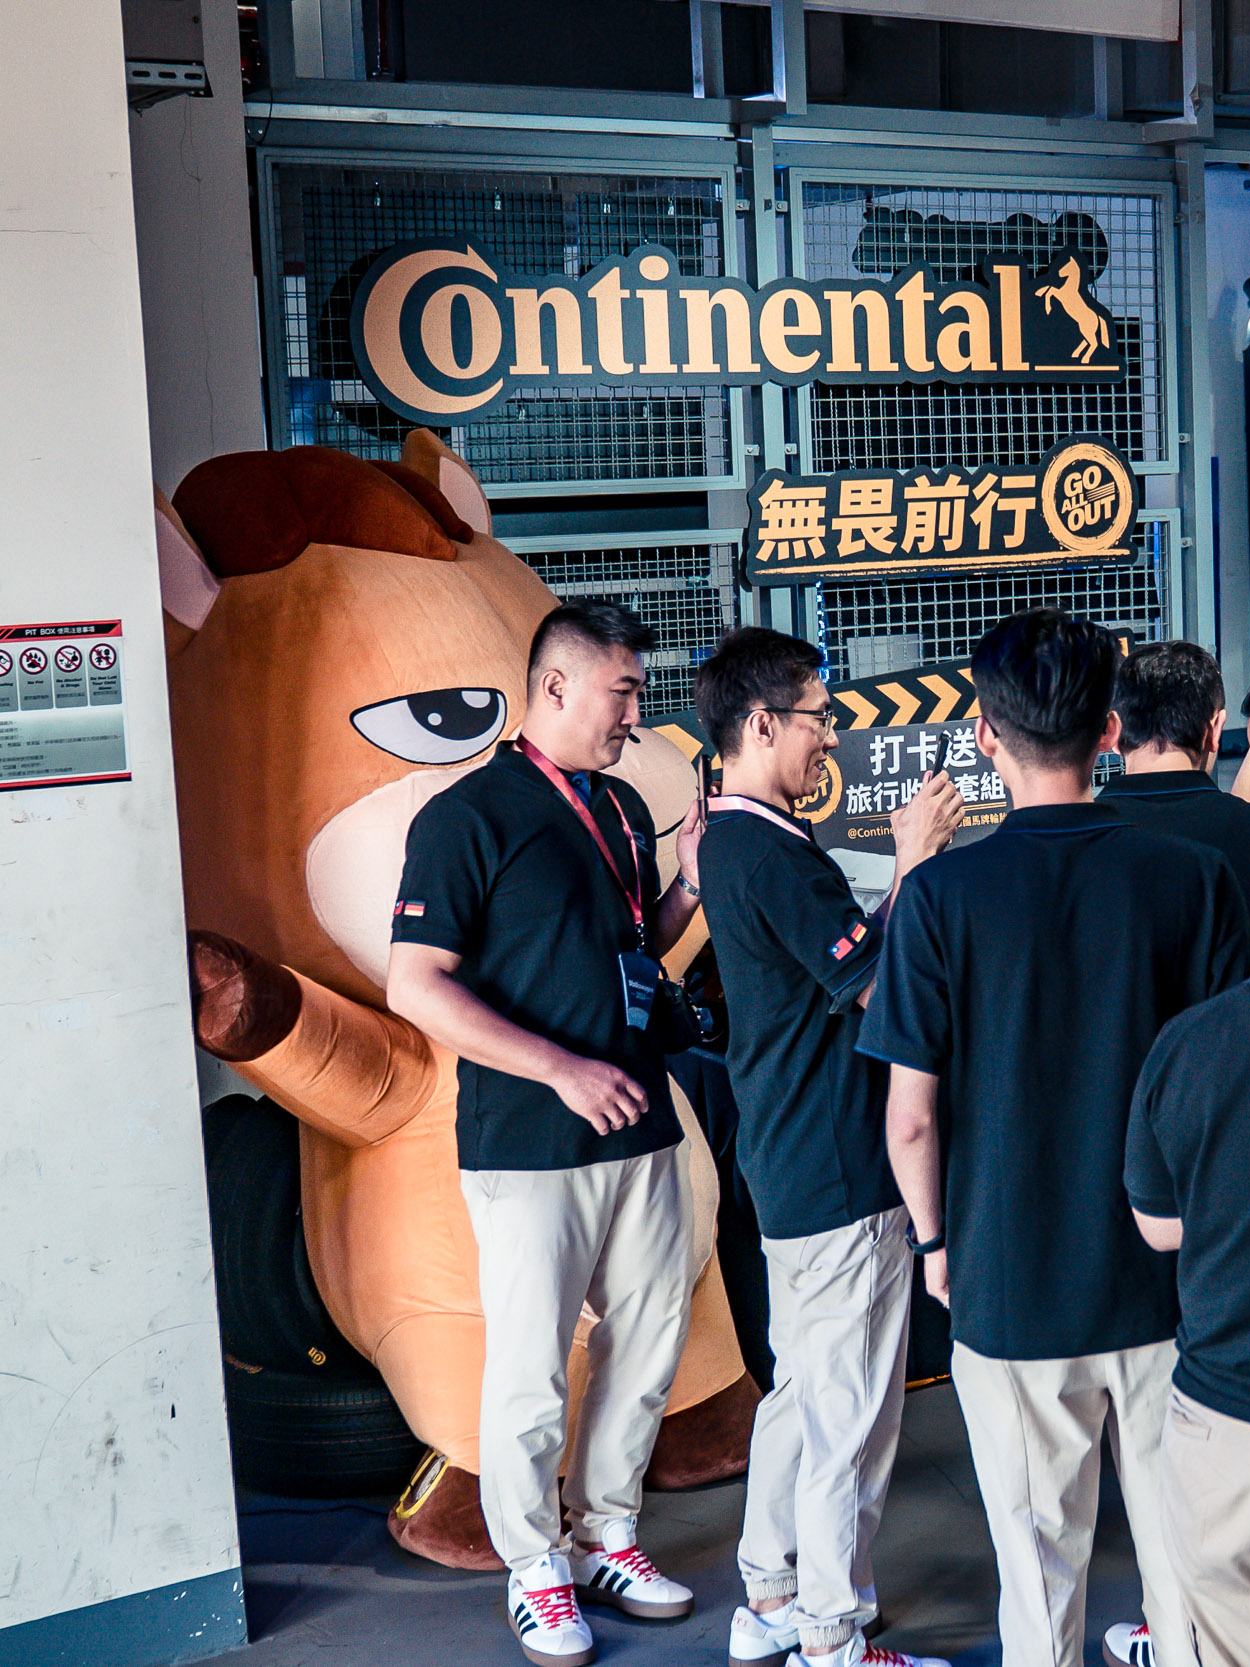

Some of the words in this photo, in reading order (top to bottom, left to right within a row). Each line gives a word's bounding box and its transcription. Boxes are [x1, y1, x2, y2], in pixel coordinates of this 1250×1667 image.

[363, 245, 1030, 414] Continental
[1063, 465, 1102, 498] GO
[756, 474, 1036, 562] 無畏前行
[1061, 493, 1089, 514] ALL
[1067, 494, 1116, 532] OUT
[25, 628, 37, 636] PIT
[40, 627, 56, 635] BOX
[869, 727, 977, 776] 打卡送
[846, 771, 1006, 815] 旅行收套組
[847, 825, 895, 840] @Contine
